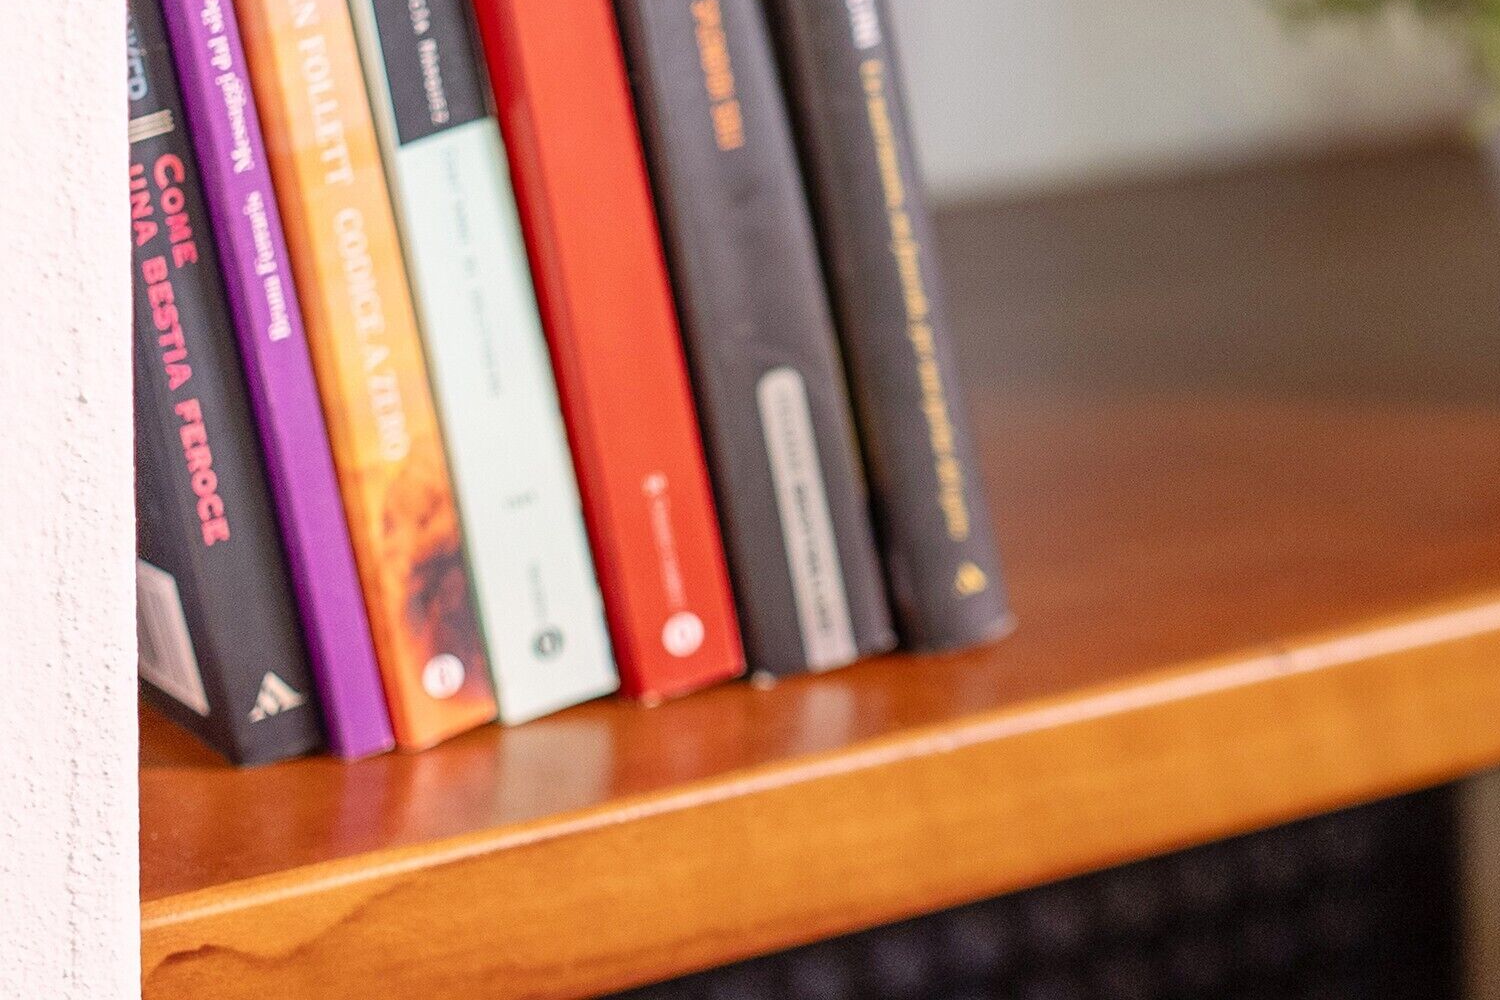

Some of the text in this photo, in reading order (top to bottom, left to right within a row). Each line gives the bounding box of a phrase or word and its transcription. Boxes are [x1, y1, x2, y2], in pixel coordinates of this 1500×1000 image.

[208, 37, 233, 71] dal
[215, 72, 255, 173] Messaggi
[298, 35, 352, 186] FOLLETT
[260, 275, 292, 341] Bruna
[334, 208, 384, 336] CODICE
[129, 163, 231, 546] UNA BESTIA FEROCE
[364, 337, 390, 371] A
[367, 372, 409, 461] ZERO
